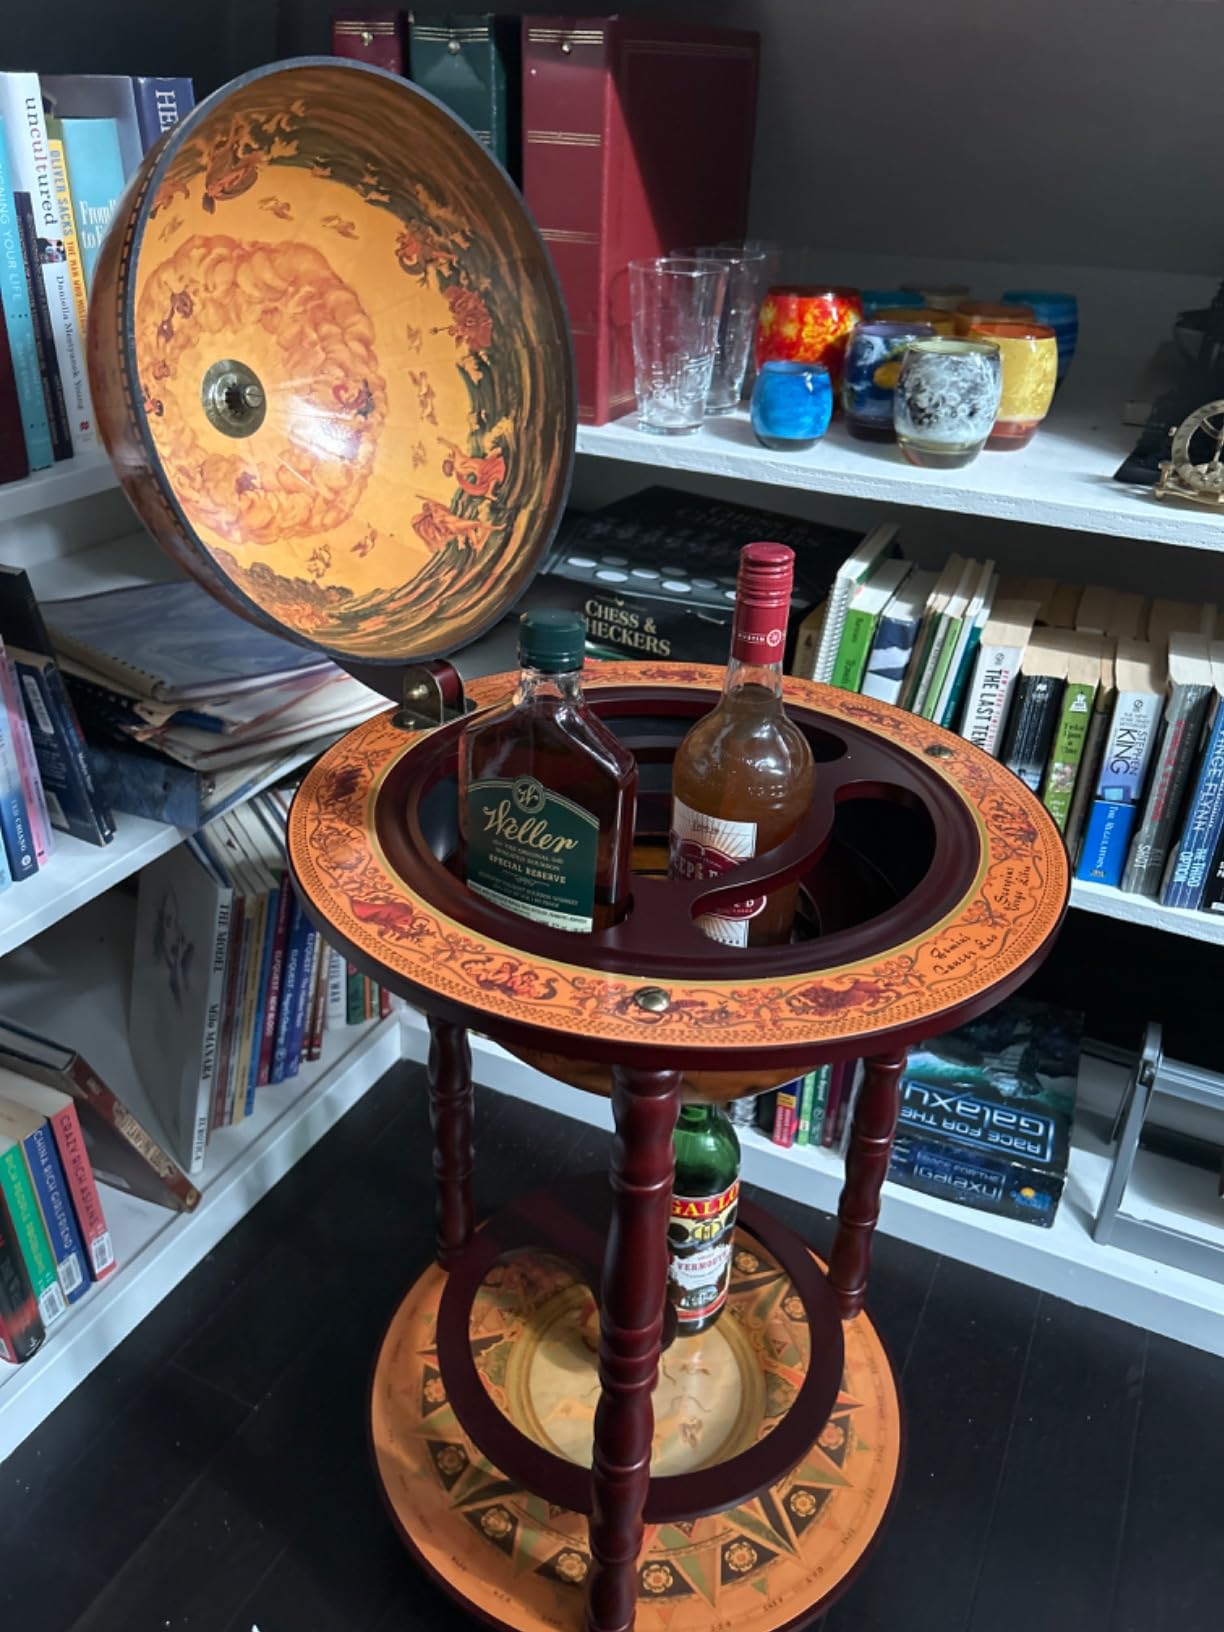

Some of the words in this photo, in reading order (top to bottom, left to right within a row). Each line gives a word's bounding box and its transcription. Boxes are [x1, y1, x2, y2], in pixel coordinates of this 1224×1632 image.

[25, 97, 58, 225] uncultured
[51, 150, 65, 191] OLIVER
[56, 197, 74, 241] SACKS
[3, 231, 17, 268] YOUR
[56, 276, 70, 320] Daniella
[585, 599, 639, 628] CHESS
[643, 616, 657, 635] &
[982, 668, 1002, 690] THE
[976, 692, 996, 722] LAST
[1110, 728, 1138, 775] KING
[1129, 730, 1148, 776] STEPHEN
[482, 799, 579, 853] Weller
[1192, 783, 1218, 833] FLYNN
[16, 818, 27, 852] CHIANG
[488, 853, 523, 873] SPECIAL
[525, 866, 567, 885] RESERVE
[1134, 843, 1151, 869] SHOT
[1174, 851, 1194, 883] OPTION
[1187, 863, 1207, 888] THIRD
[218, 904, 230, 930] THE
[213, 931, 228, 973] MODEL
[271, 950, 283, 991] ELFQUEST
[287, 949, 299, 988] ELFQUEST
[303, 932, 315, 973] ELFQUEST
[330, 983, 341, 1003] WAR
[208, 1002, 219, 1028] Milo
[201, 1029, 218, 1080] MANARA
[900, 1106, 937, 1125] THE
[941, 1118, 983, 1138] FOR
[34, 1130, 48, 1166] CHINA
[44, 1165, 56, 1192] RICH
[50, 1191, 73, 1249] GIRLFRIEND
[62, 1115, 77, 1153] CRAZY
[72, 1155, 87, 1184] RICH
[81, 1186, 98, 1227] ASIANS
